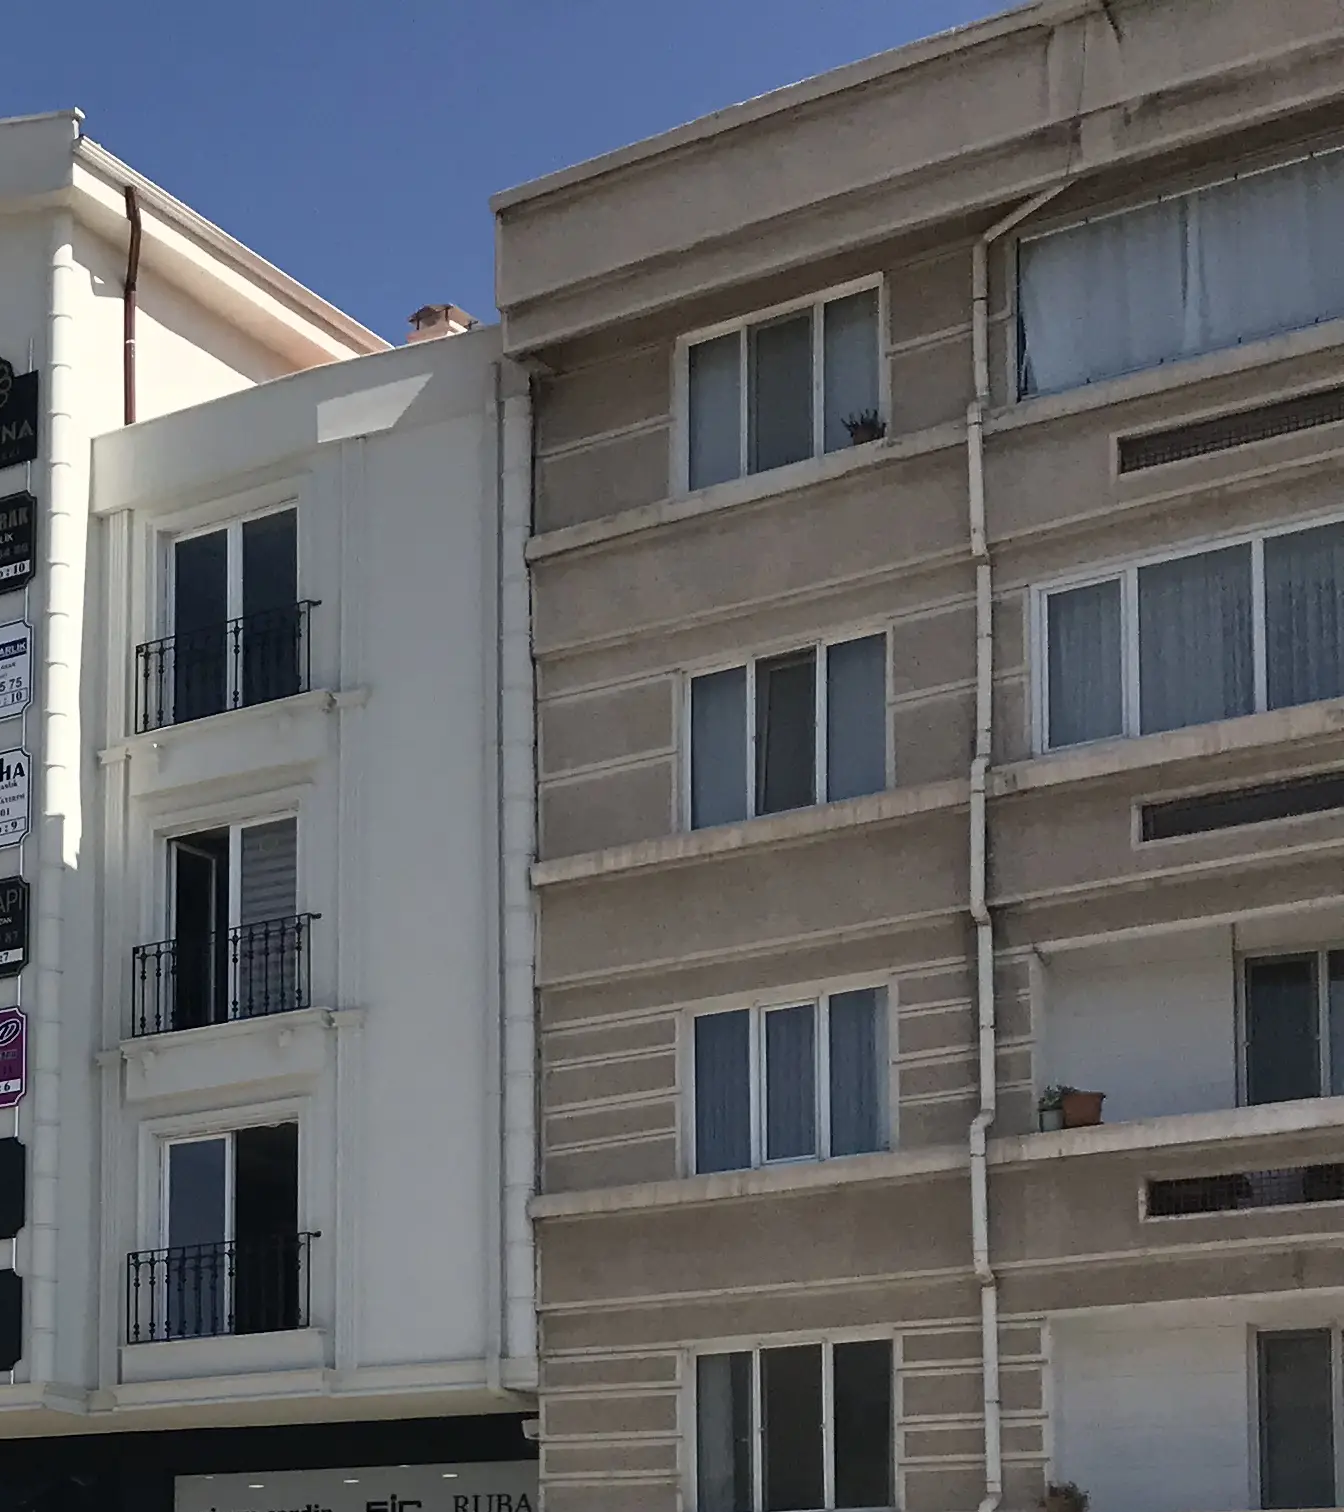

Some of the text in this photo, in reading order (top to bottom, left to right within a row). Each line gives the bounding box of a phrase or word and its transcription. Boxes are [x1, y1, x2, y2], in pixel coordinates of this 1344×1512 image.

[14, 562, 25, 574] 10
[9, 676, 23, 688] 75
[12, 692, 23, 703] 10
[11, 820, 18, 830] 9
[4, 1082, 10, 1091] 6
